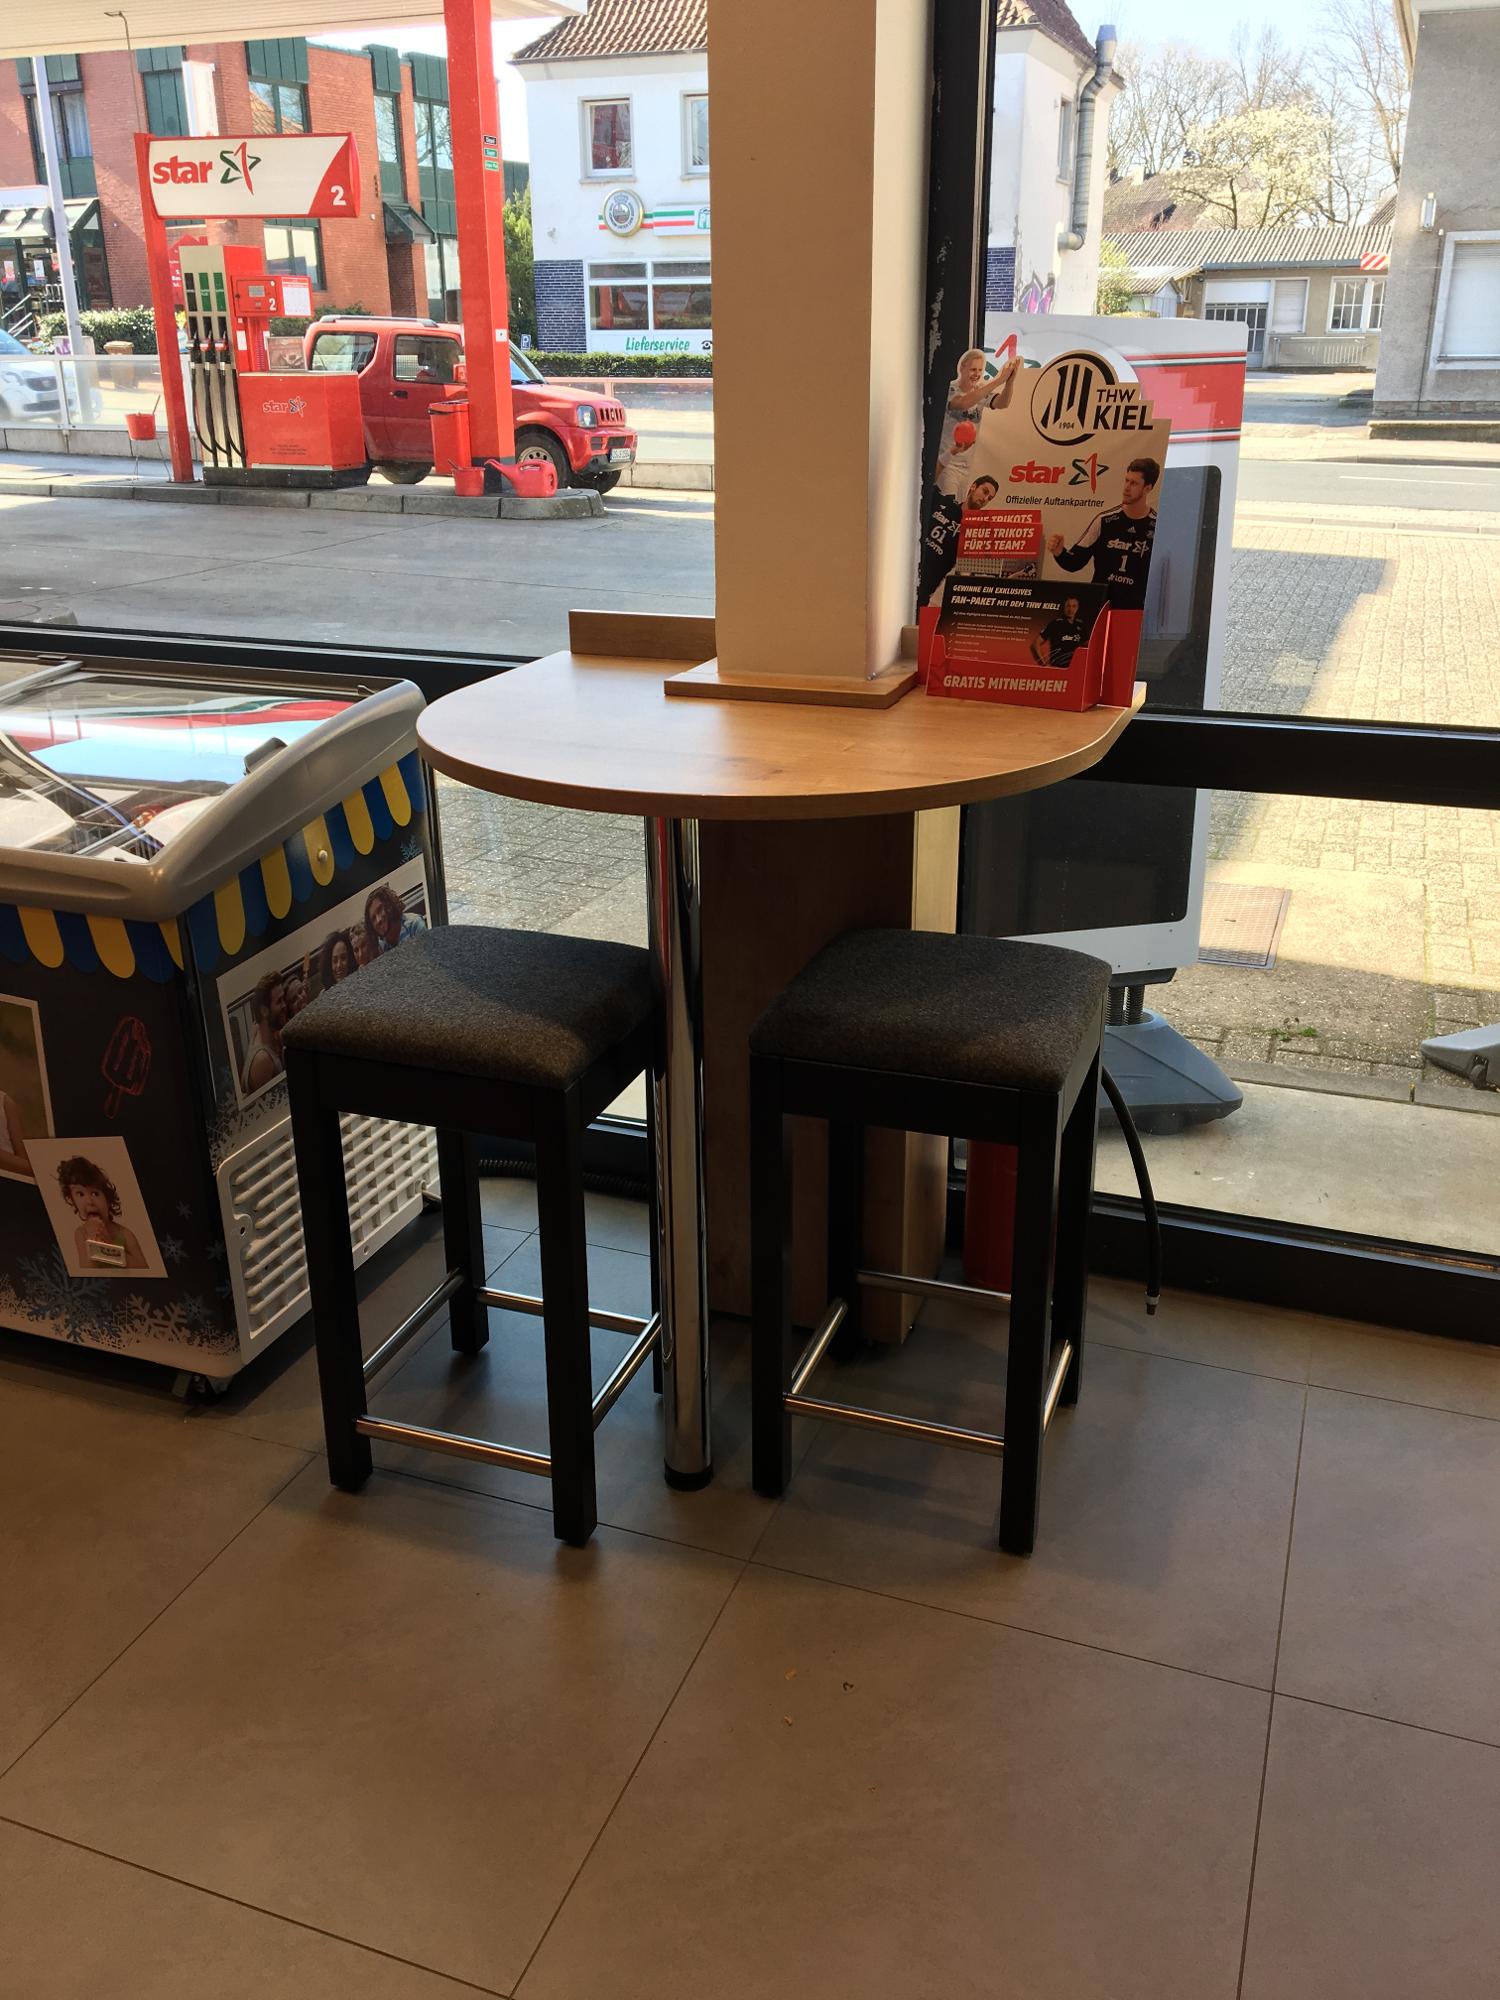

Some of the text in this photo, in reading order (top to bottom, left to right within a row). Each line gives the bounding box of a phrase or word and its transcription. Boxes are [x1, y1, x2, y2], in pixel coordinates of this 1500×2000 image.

[153, 155, 213, 184] star
[330, 185, 347, 206] 2
[269, 298, 277, 311] 2
[626, 336, 690, 351] Lieferservice
[1096, 389, 1136, 403] THW
[263, 400, 288, 413] star
[1093, 405, 1153, 430] KIEL
[1058, 422, 1075, 430] 1904
[1008, 460, 1066, 484] star
[1005, 495, 1105, 508] Offizieller Auftankpartner
[931, 525, 947, 544] 61
[964, 528, 1035, 538] NEUE TRIKOTS
[963, 539, 1026, 550] FÜR'S TEAM?
[1106, 538, 1132, 551] star
[1118, 555, 1128, 572] 1
[1114, 576, 1134, 585] LOTTO
[952, 585, 1033, 596] GEWINNE EIN EXKLUSIVES
[950, 595, 1061, 611] FAN-PAKET MIT DEM THW KIEL!
[943, 675, 1068, 692] GRATIS MITNEHMEN!
